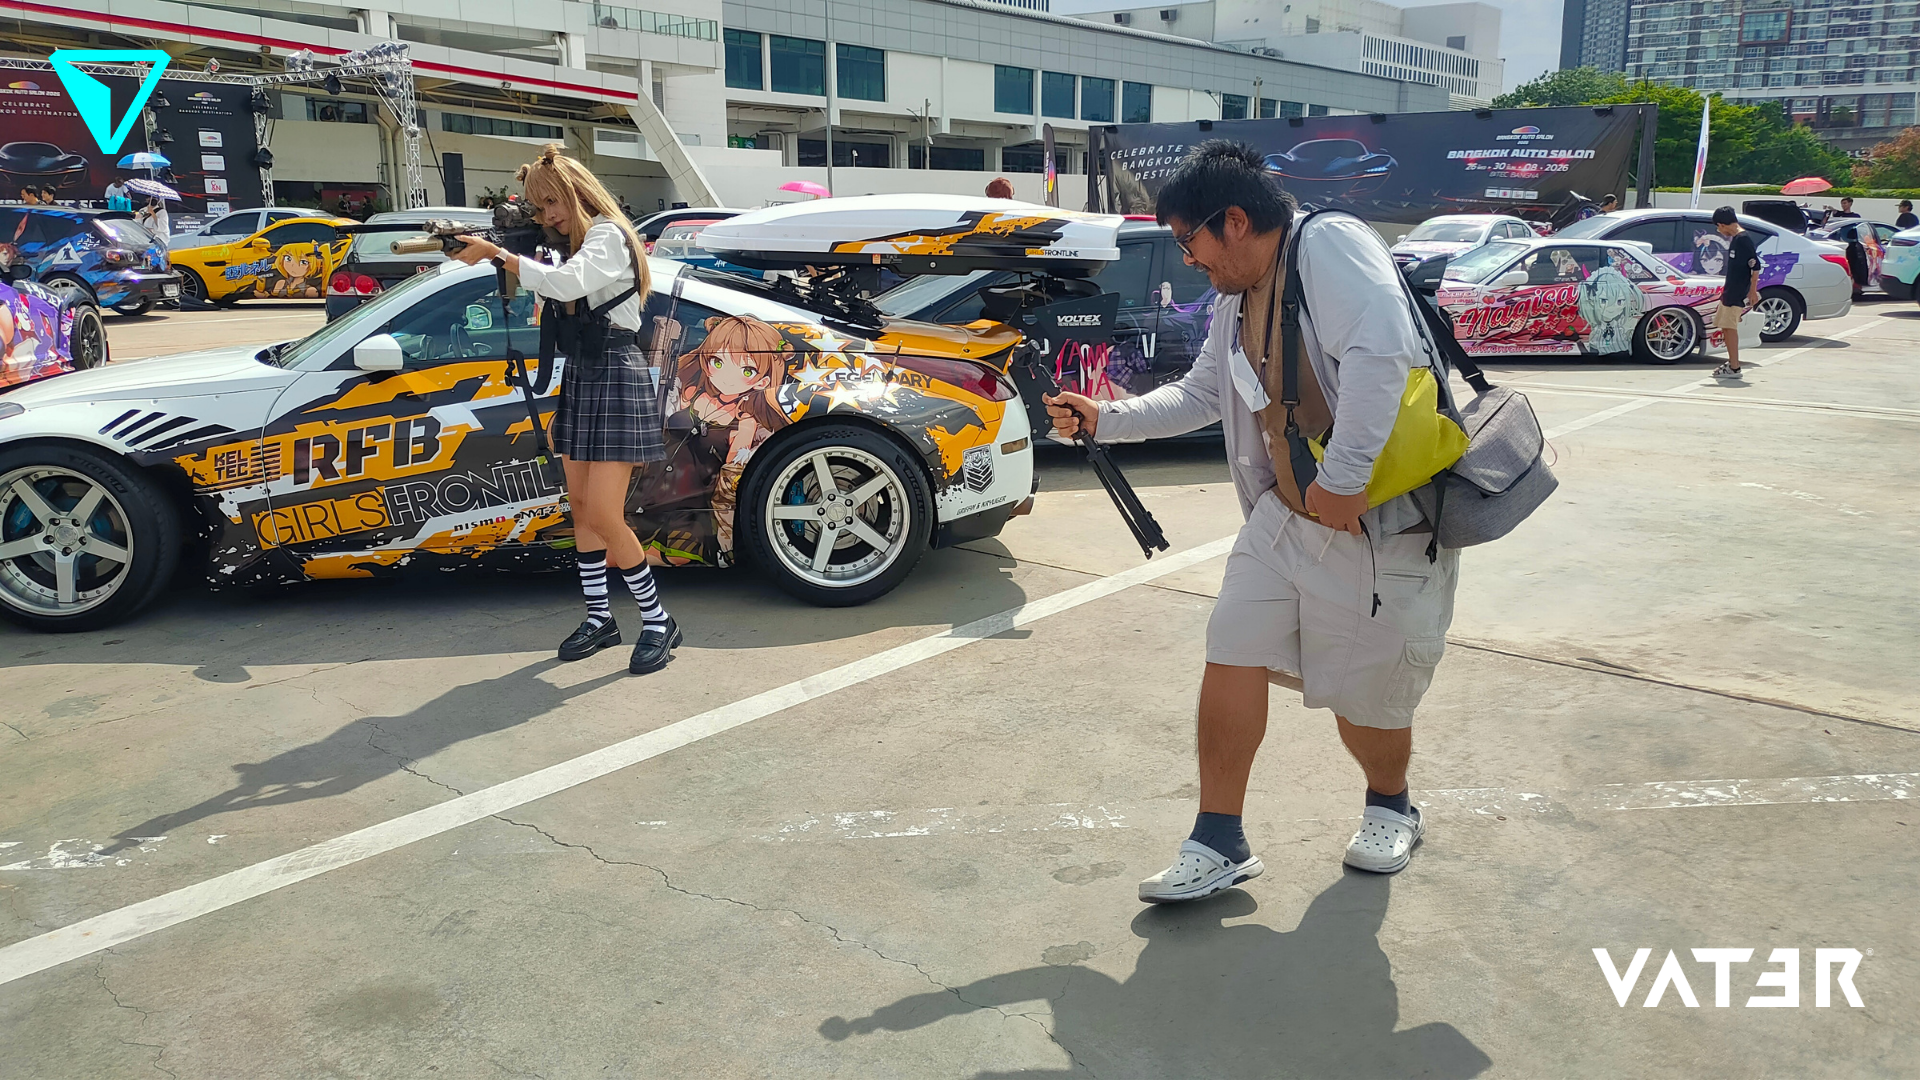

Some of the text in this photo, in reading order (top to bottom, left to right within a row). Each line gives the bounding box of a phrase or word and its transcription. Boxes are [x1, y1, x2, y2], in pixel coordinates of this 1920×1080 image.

[2, 101, 51, 109] CELEBRATE
[21, 109, 78, 117] DESTINATION
[1110, 144, 1184, 160] CELEBRATE
[1446, 148, 1596, 159] BANGKOK AUTO SALON
[1122, 156, 1183, 171] BANGKOK
[1492, 162, 1506, 170] 30
[1544, 163, 1569, 171] 2026
[1056, 314, 1102, 323] VOLTEX
[293, 415, 441, 485] RFB
[214, 449, 249, 467] KEL
[214, 462, 249, 481] TEC
[453, 515, 506, 532] nismo
